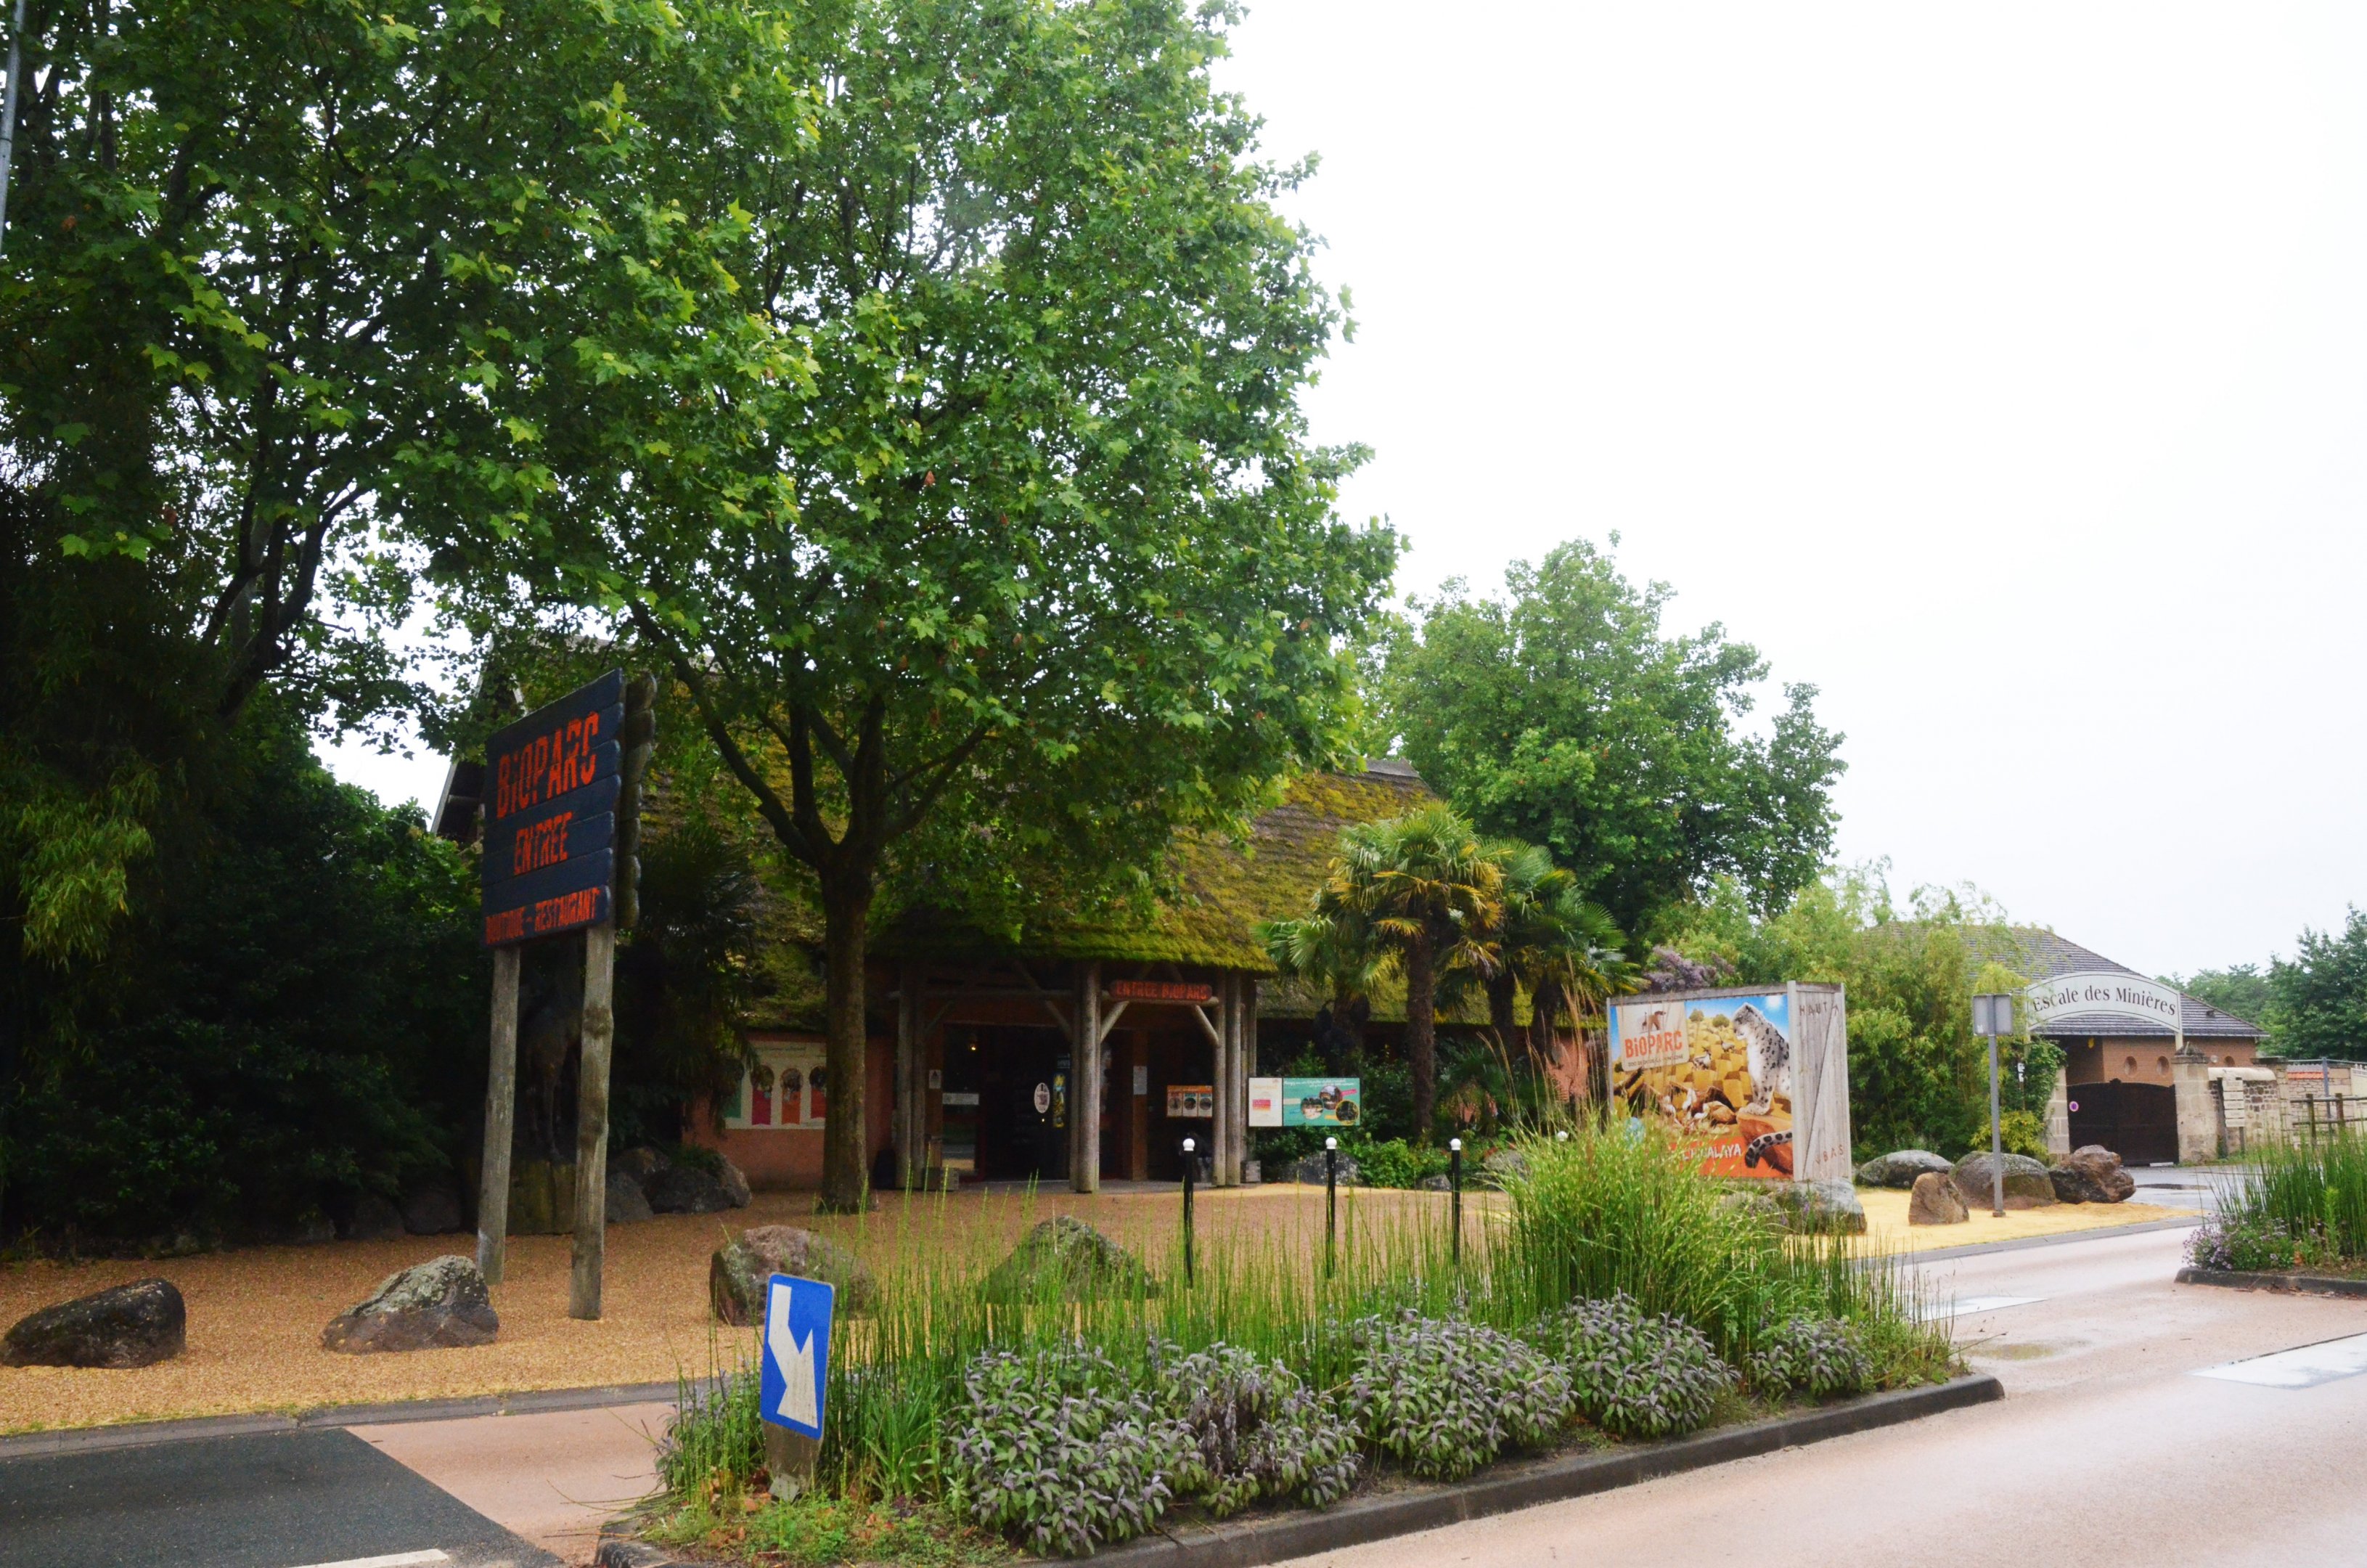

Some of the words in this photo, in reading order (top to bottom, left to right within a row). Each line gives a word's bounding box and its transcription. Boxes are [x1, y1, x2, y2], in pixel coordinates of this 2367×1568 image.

[514, 811, 573, 875] ENTREE
[534, 886, 601, 932] RESTAURANT
[1799, 1002, 1828, 1016] HAUT
[2032, 987, 2080, 1013] Escale
[2085, 984, 2110, 1002] des
[2115, 987, 2176, 1016] Minières
[1823, 1144, 1844, 1162] BAS
